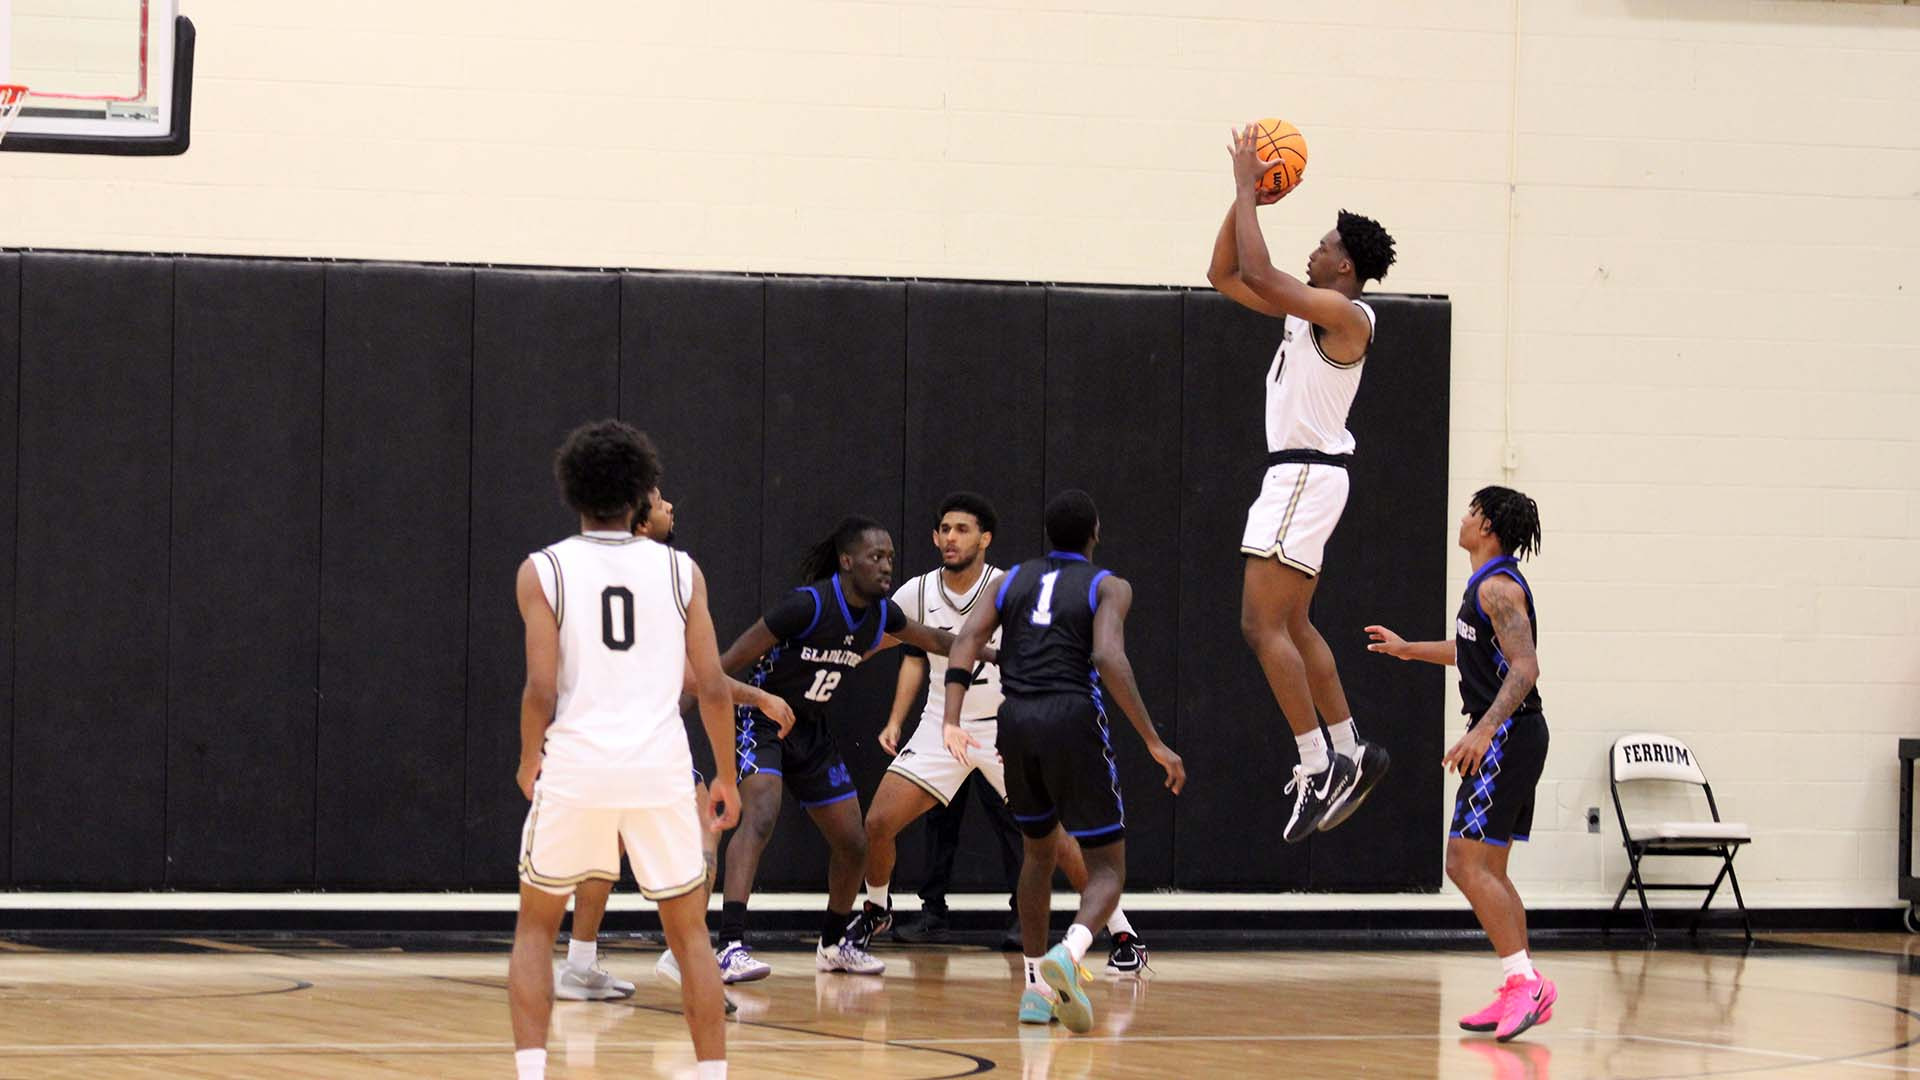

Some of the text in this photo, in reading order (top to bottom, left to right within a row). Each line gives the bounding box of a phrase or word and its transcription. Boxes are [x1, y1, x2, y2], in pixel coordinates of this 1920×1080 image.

[1274, 349, 1286, 384] 1
[1030, 569, 1060, 627] 1
[601, 586, 635, 651] 0
[804, 669, 842, 702] 12
[1622, 743, 1690, 767] FERRUM
